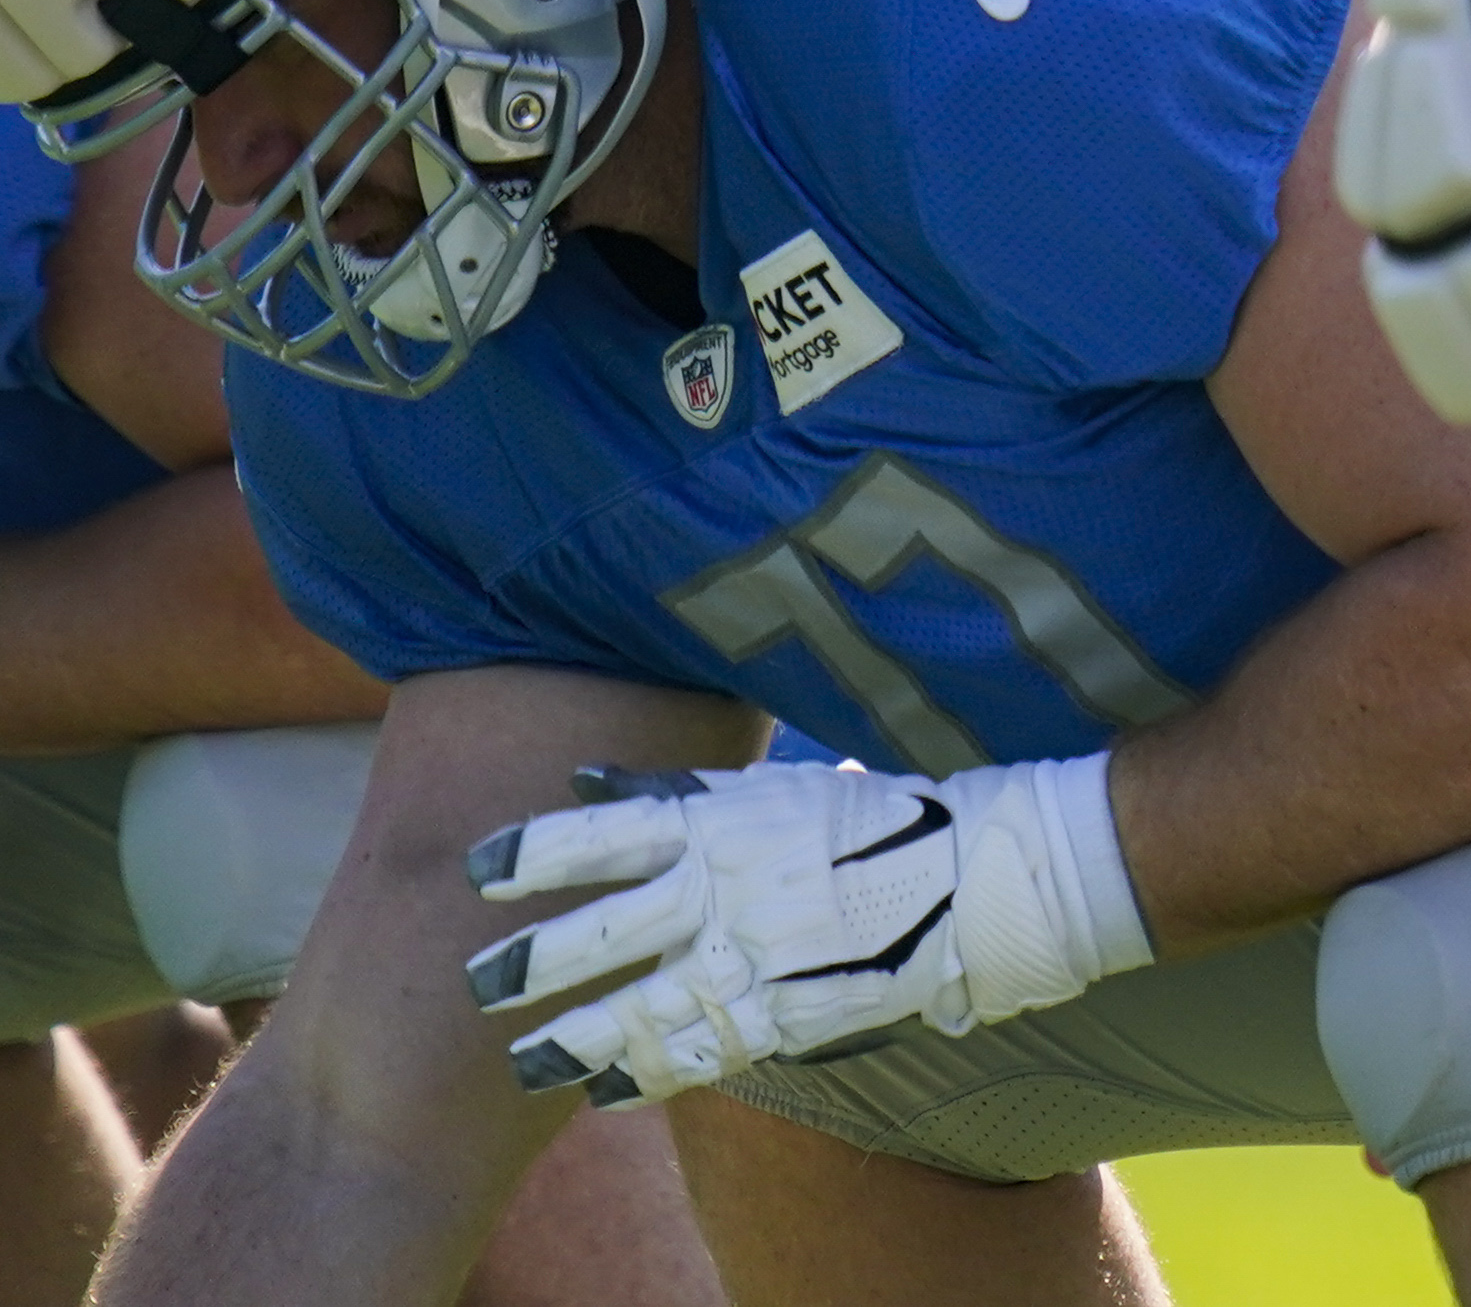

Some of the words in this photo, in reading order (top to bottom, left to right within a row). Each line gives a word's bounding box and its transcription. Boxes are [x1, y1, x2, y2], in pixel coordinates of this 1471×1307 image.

[753, 260, 843, 346] CKET
[688, 376, 716, 407] NFL
[656, 448, 1202, 784] 77
